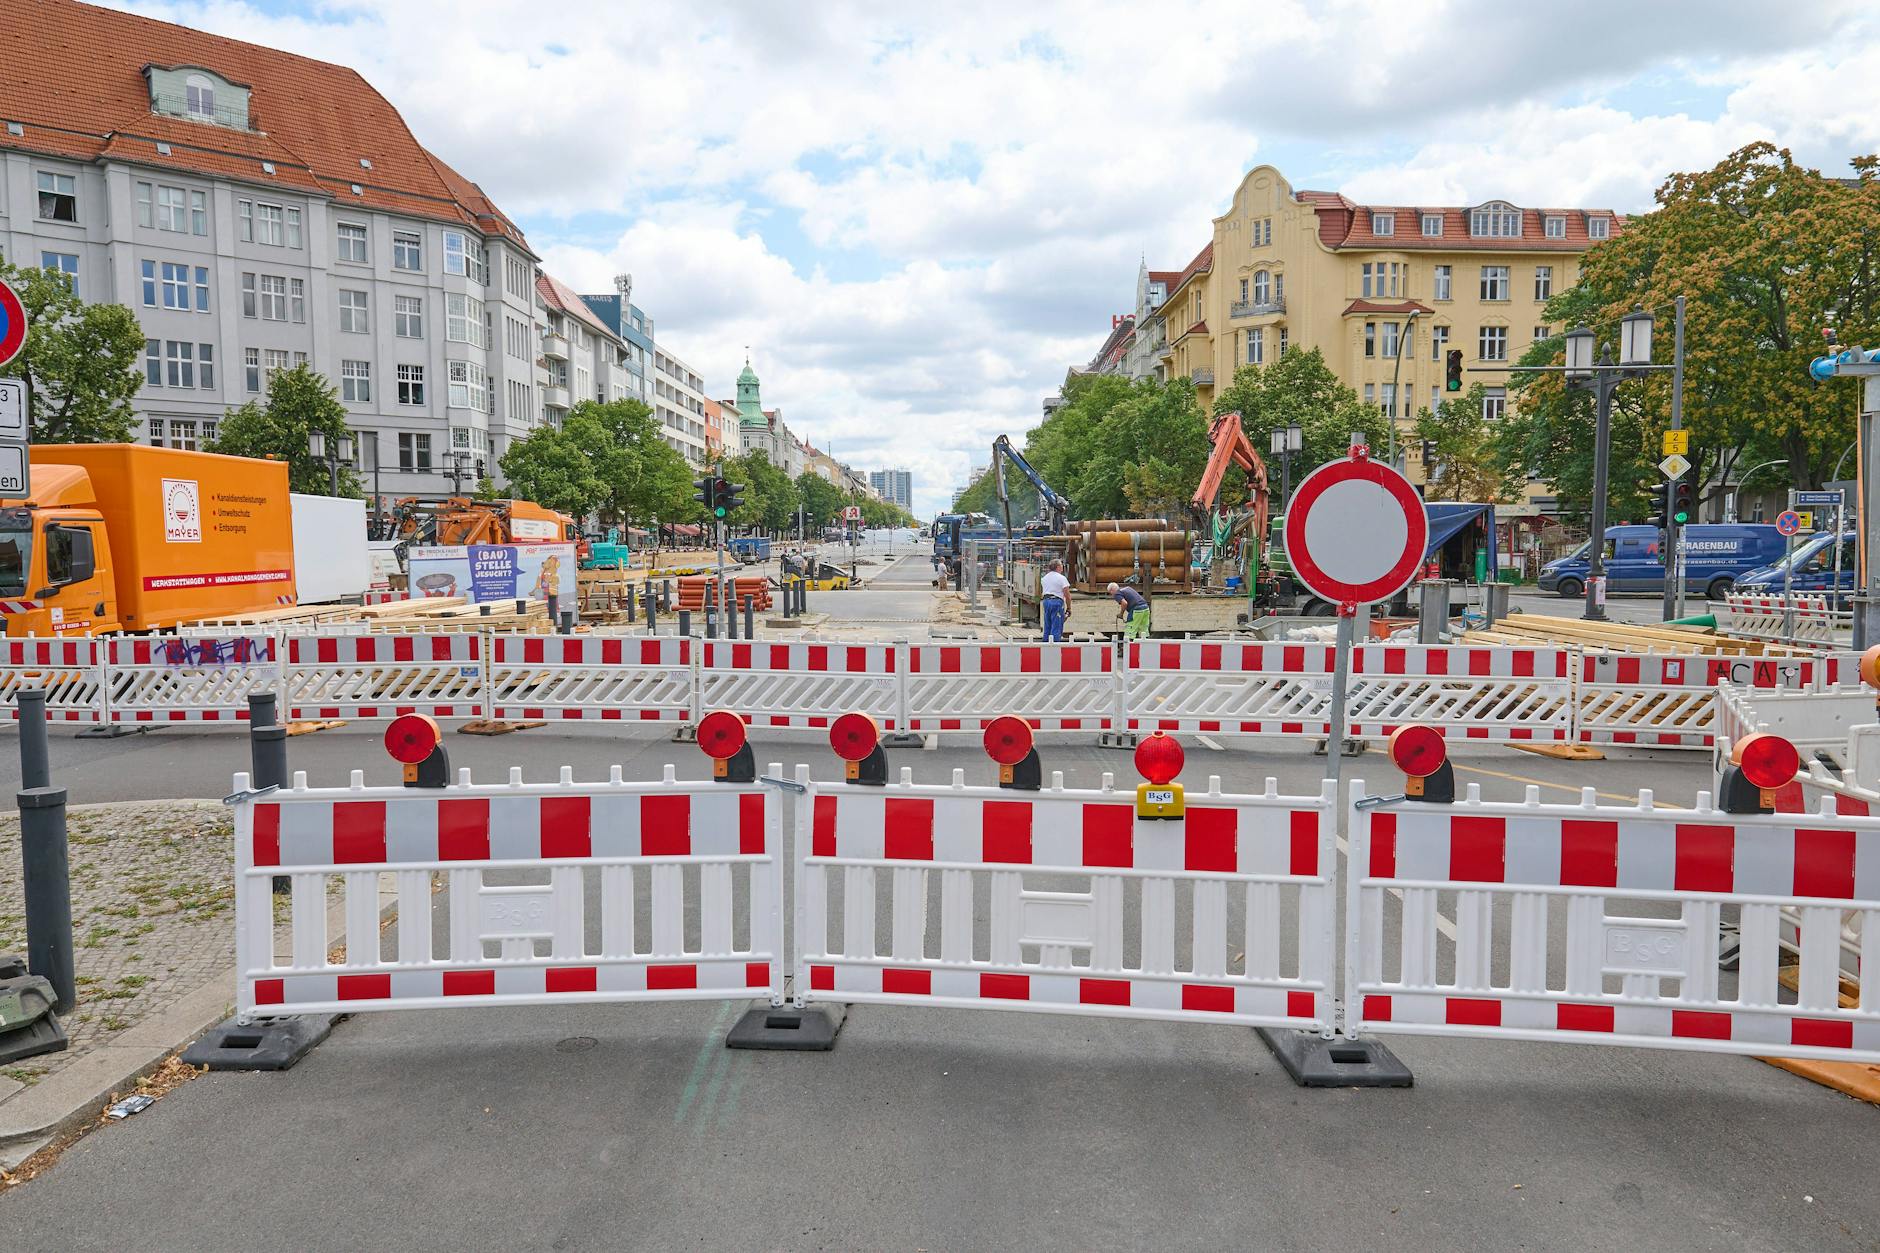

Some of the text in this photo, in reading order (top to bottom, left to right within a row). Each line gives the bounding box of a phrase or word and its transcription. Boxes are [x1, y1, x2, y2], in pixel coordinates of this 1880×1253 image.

[1673, 432, 1679, 441] 2
[1672, 444, 1679, 453] 5
[217, 493, 267, 505] Kanaldienstleistungen
[218, 508, 251, 518] Umweltschutz
[168, 528, 199, 538] MAYER
[219, 523, 247, 534] Entsorgung
[478, 549, 508, 561] (BAU)
[475, 560, 512, 571] STELLE
[475, 570, 513, 578] JESUCHT?
[151, 576, 206, 588] WERKSTATTWAGEN
[1148, 792, 1172, 802] BSG
